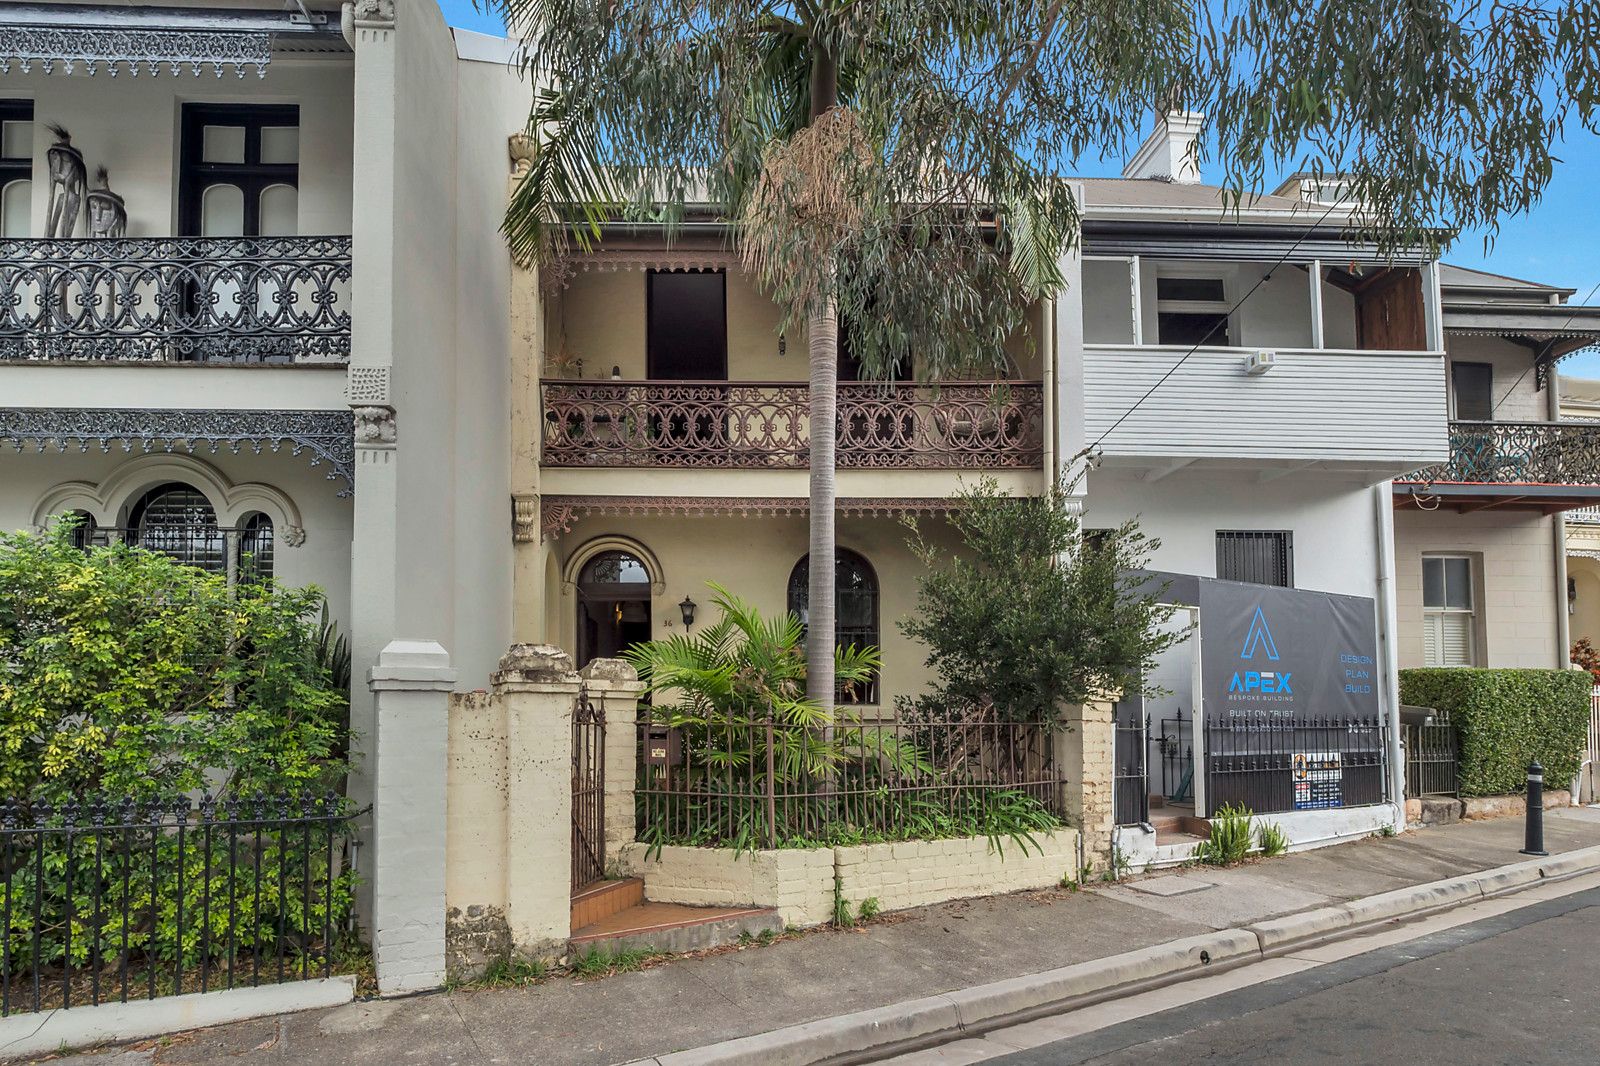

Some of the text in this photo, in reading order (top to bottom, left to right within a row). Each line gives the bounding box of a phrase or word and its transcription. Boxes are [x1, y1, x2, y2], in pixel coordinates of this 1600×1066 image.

[1340, 654, 1373, 664] DESIGN
[1345, 669, 1369, 679] PLAN
[1229, 671, 1293, 693] APEX
[1345, 684, 1371, 694] BUILD
[1229, 709, 1252, 717] BUILT
[1254, 709, 1267, 717] ON
